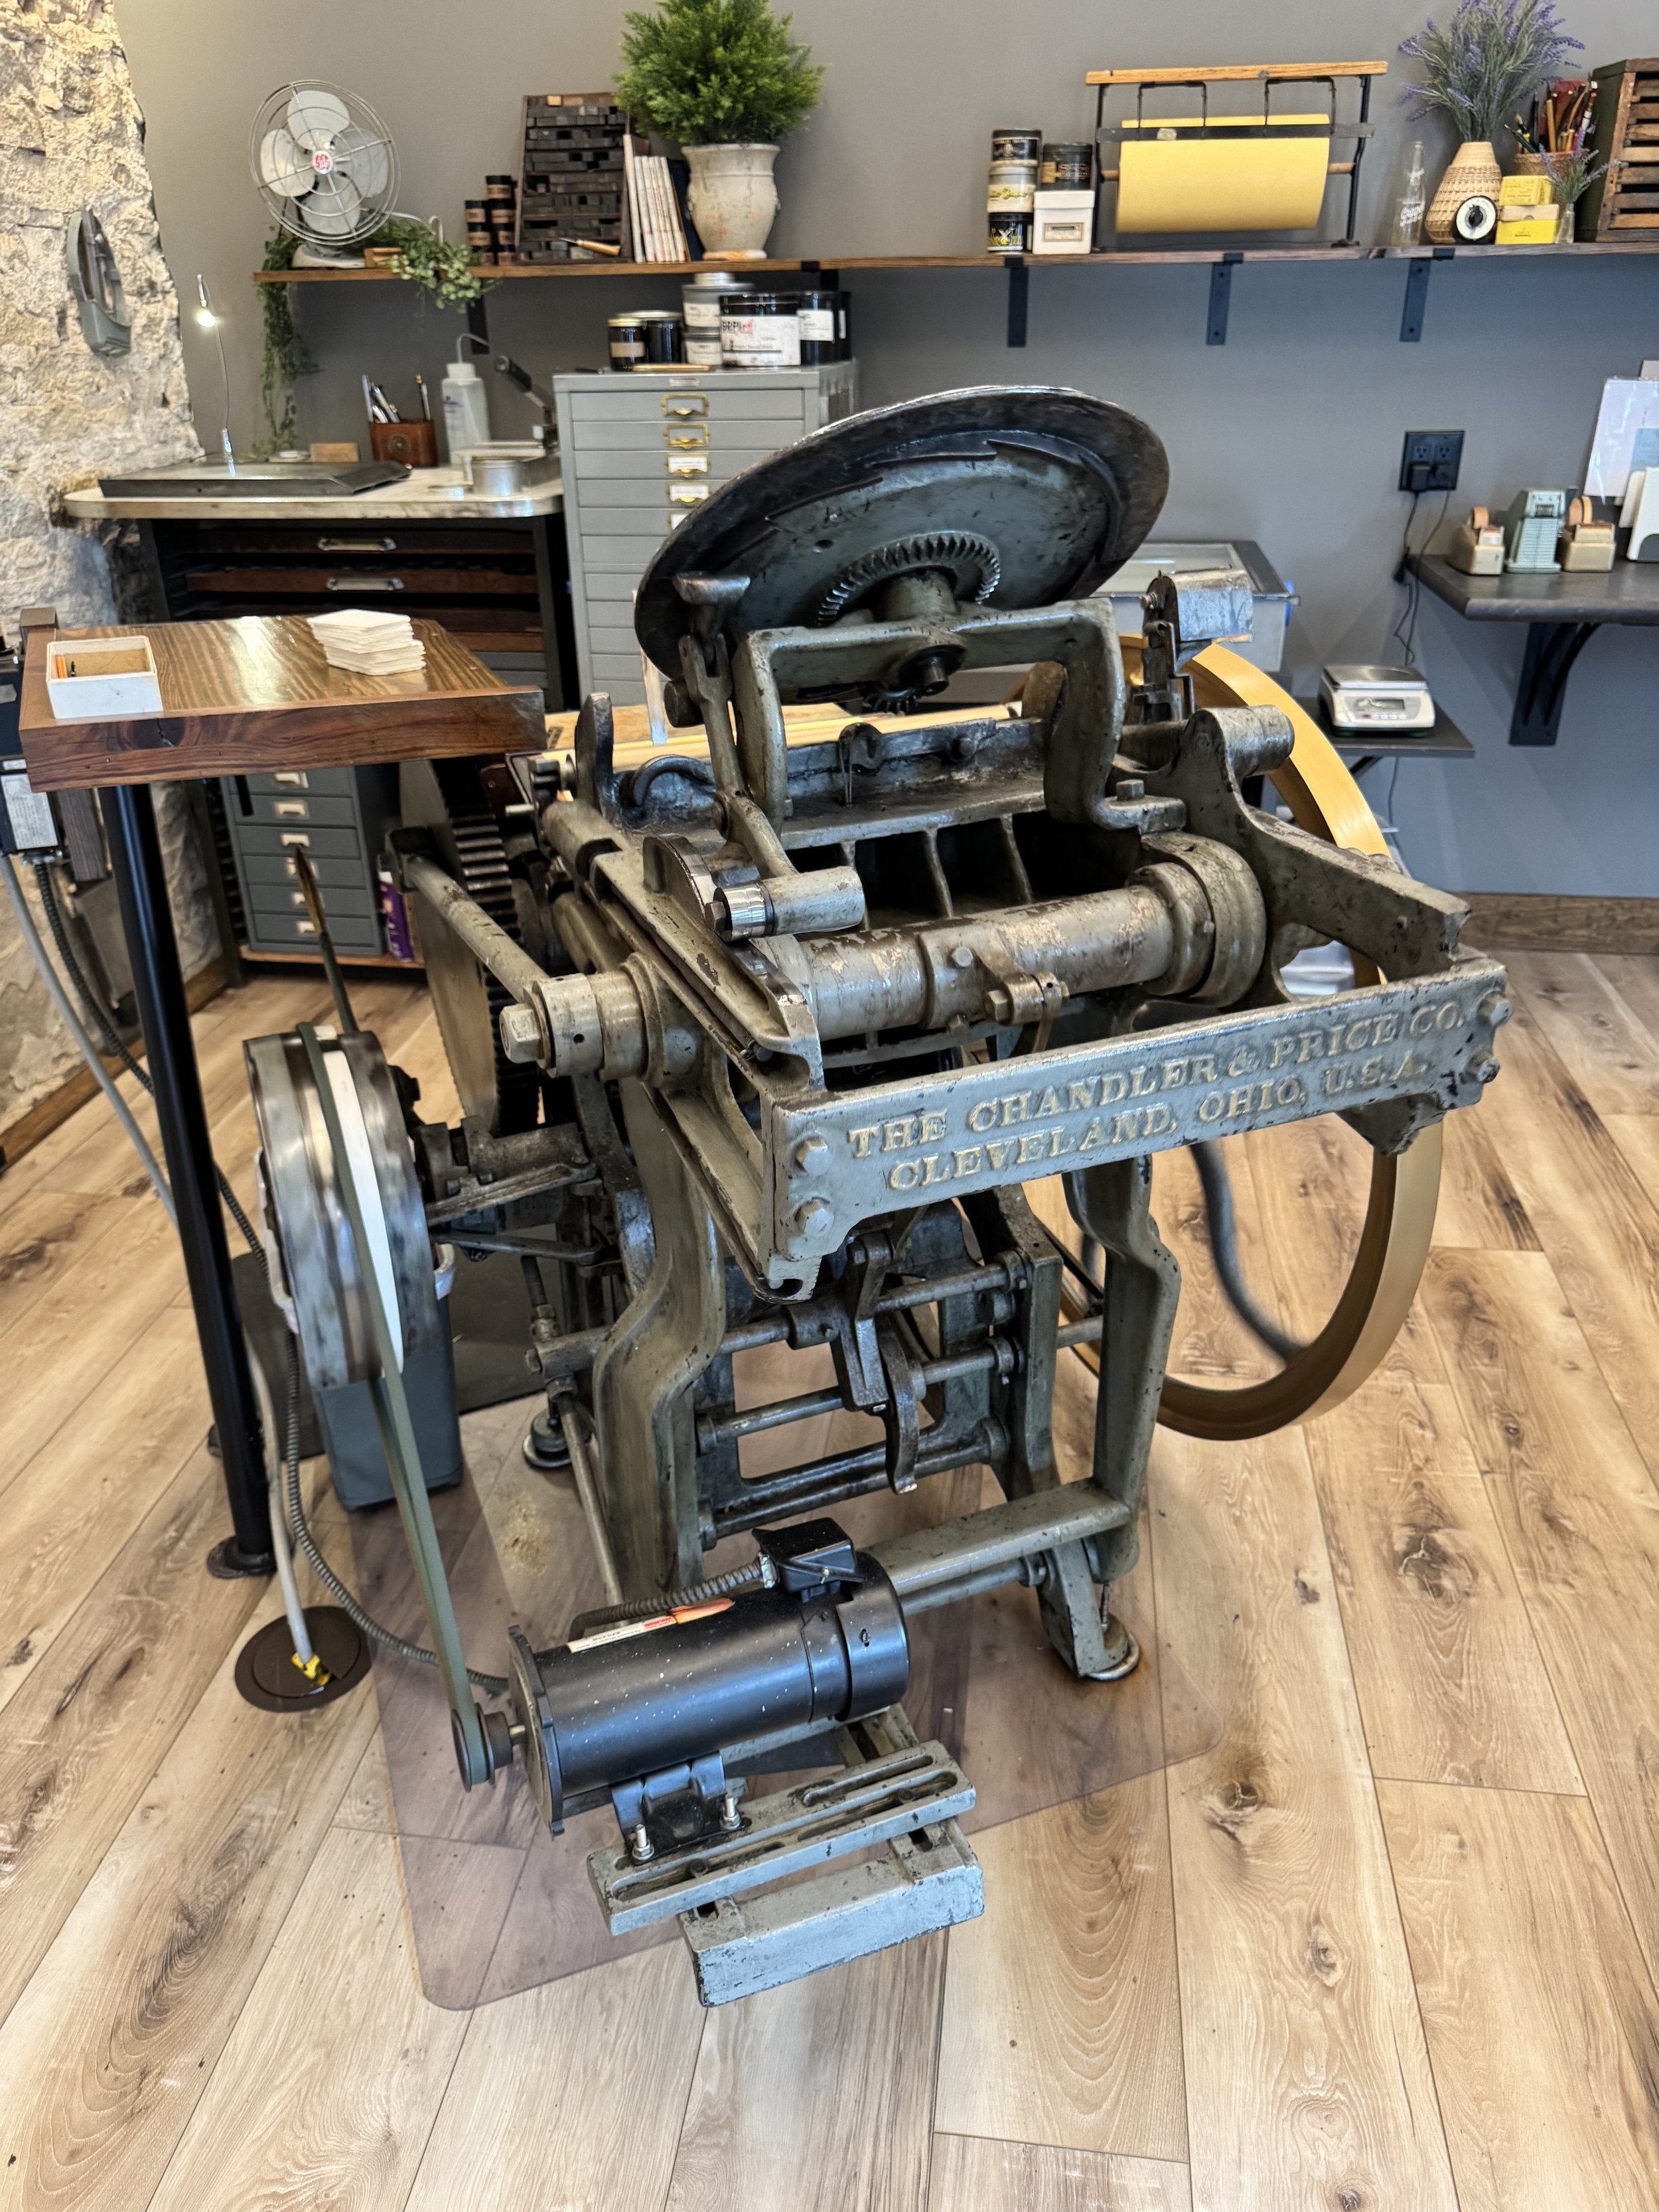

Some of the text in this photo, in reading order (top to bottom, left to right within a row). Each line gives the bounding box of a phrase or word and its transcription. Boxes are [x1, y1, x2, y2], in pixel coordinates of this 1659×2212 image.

[847, 1001, 1464, 1159] THE CHANDLER & PRICE CO.
[887, 1102, 1179, 1190] CLEVELAND,
[1198, 1074, 1307, 1122] OHIO,
